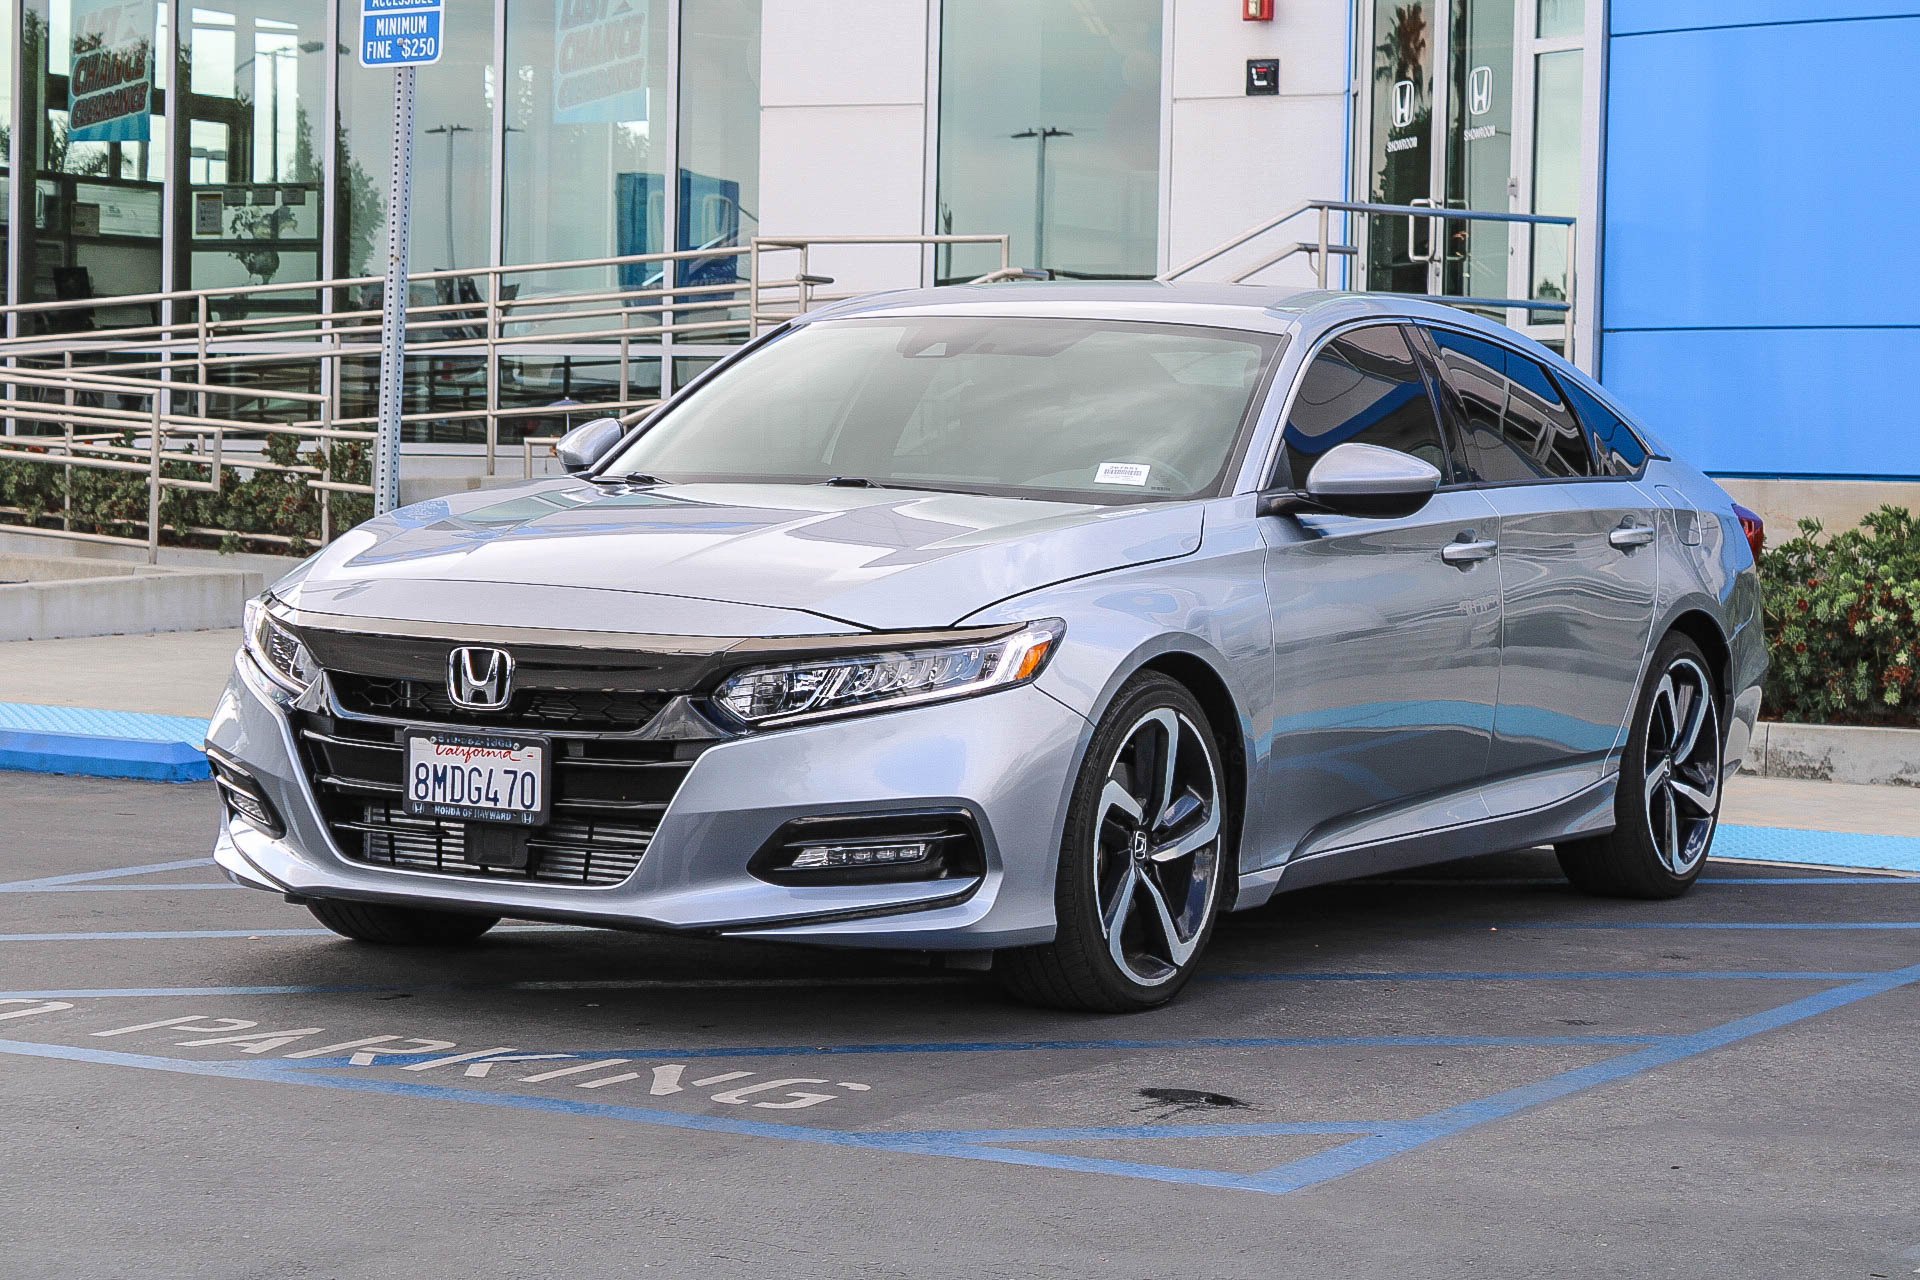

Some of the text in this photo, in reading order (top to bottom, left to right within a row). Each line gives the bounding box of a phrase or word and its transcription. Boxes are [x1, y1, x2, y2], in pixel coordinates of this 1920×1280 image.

[375, 16, 427, 37] MINIMUM
[366, 37, 435, 60] FINE $250
[72, 39, 149, 97] CHANCE
[1387, 136, 1418, 152] SHOWROOM
[1463, 125, 1496, 142] SHOWROOM
[435, 744, 521, 763] California
[415, 763, 536, 809] 8MDG470
[434, 805, 512, 821] HONDA OF HAYWARD
[88, 1015, 871, 1109] PARKING
